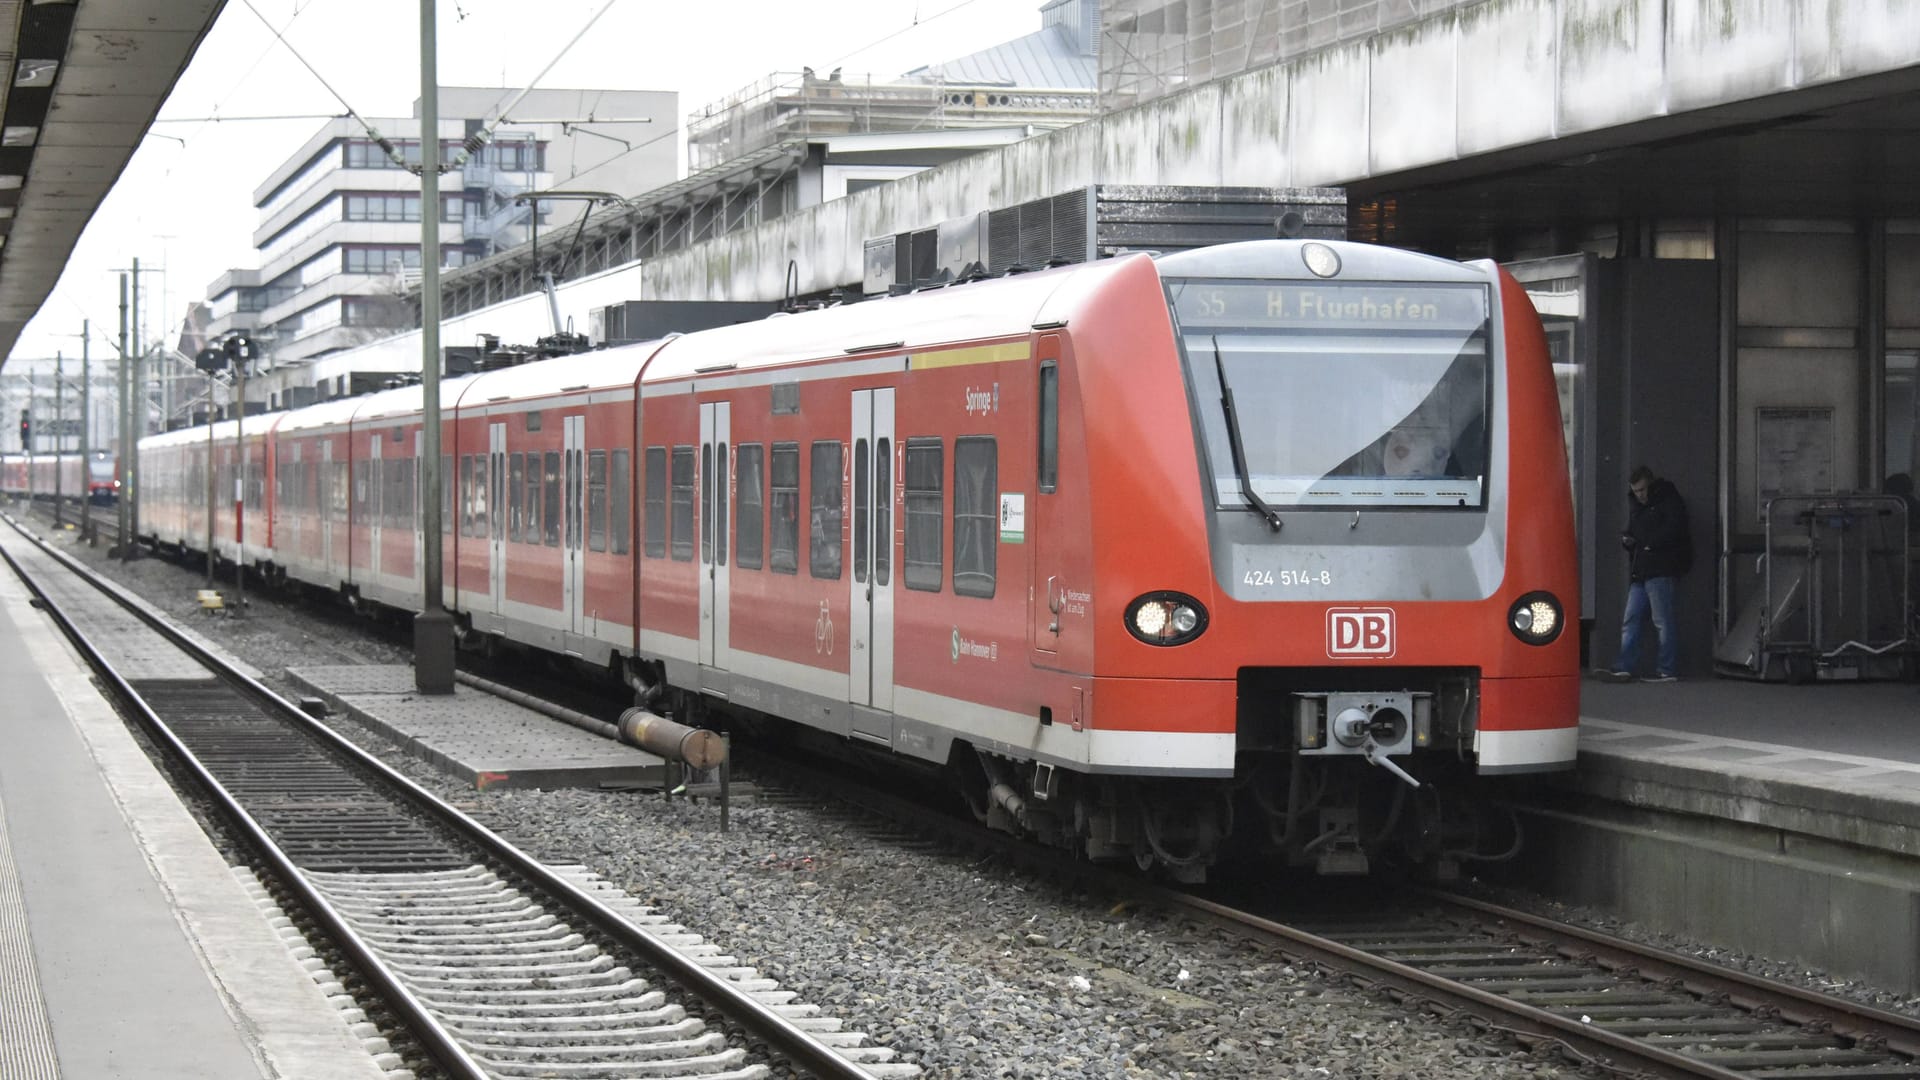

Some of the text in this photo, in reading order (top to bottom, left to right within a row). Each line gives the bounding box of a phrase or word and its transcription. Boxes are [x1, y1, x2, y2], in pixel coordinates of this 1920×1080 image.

[1197, 290, 1226, 318] S5
[1266, 290, 1290, 318] H.
[965, 386, 991, 416] Springe
[1243, 570, 1331, 586] 424 514-8
[1335, 615, 1388, 650] DB
